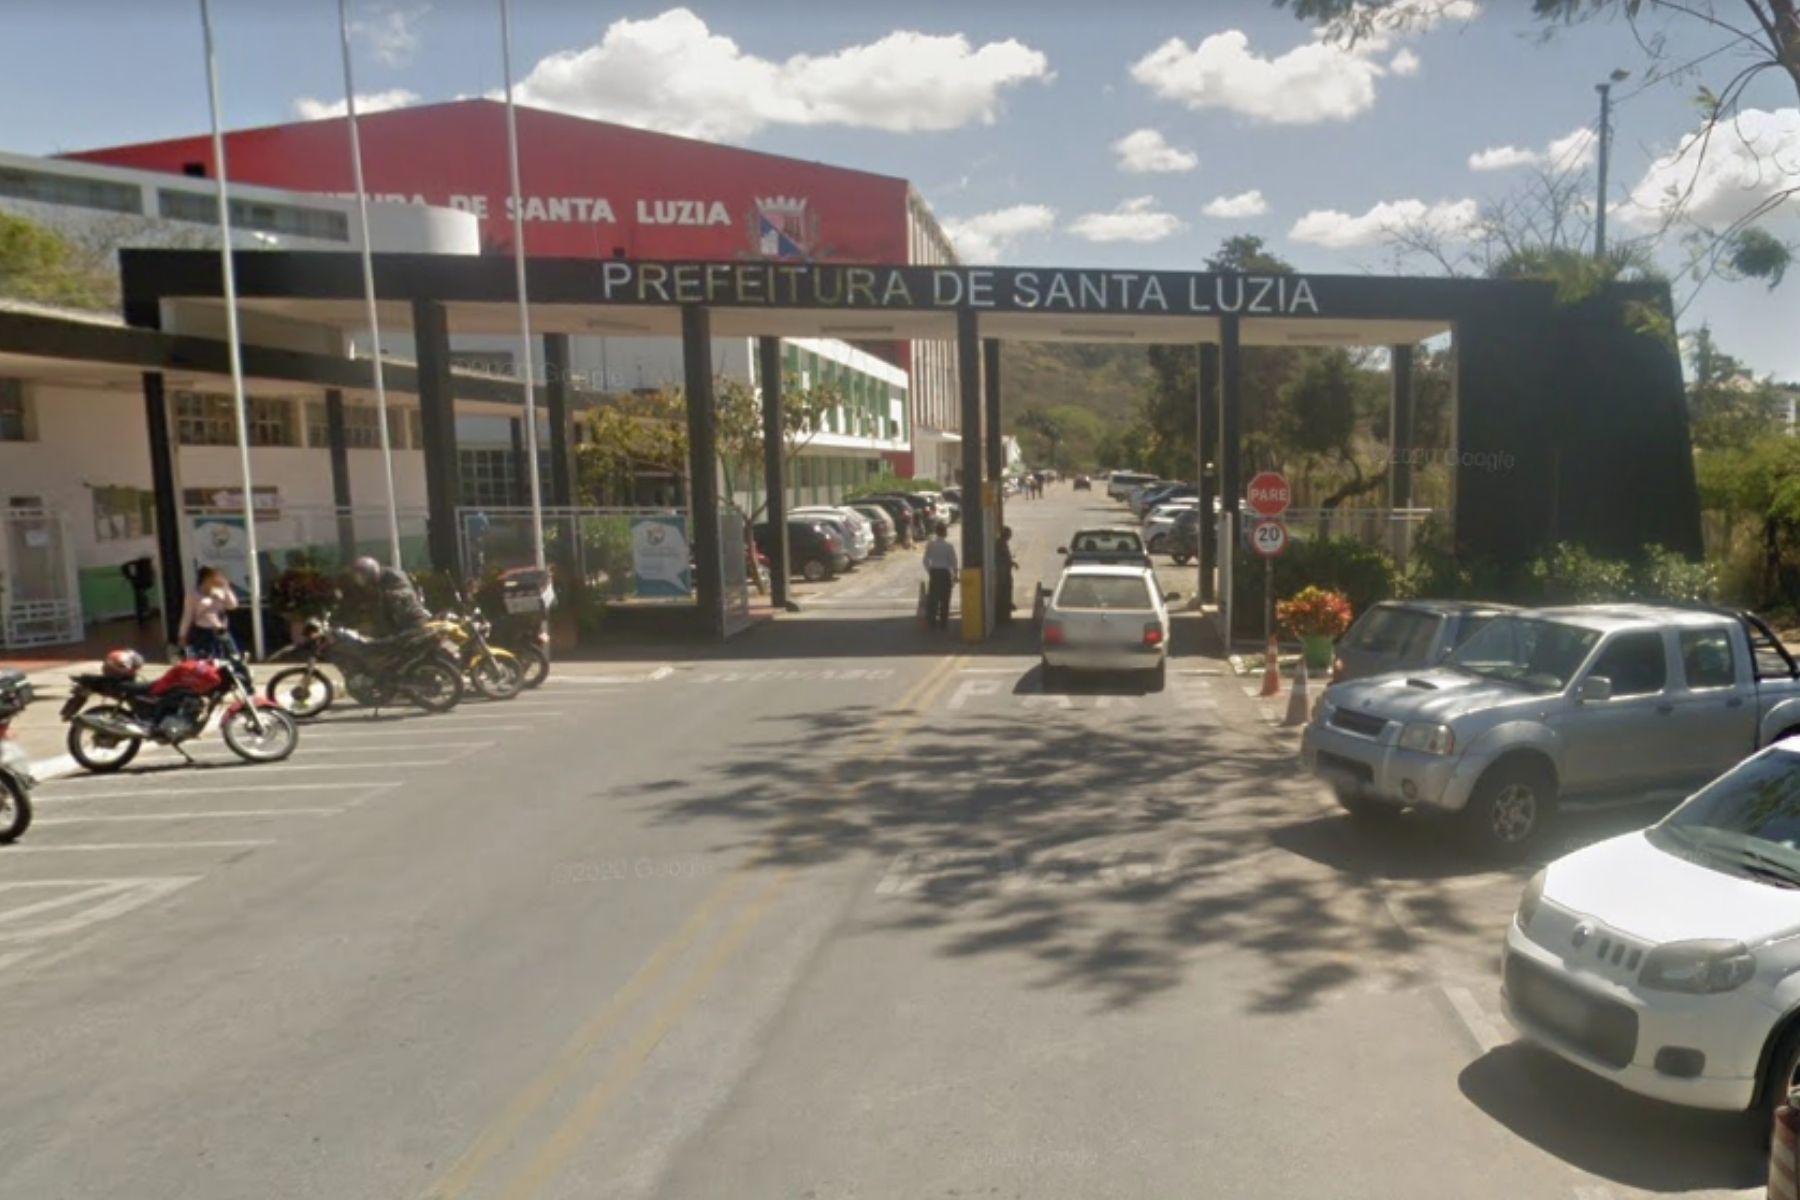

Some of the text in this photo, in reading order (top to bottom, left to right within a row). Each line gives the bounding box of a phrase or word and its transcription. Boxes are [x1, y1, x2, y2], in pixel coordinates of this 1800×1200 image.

[505, 196, 617, 223] SANTA
[636, 198, 732, 226] LUZIA
[602, 262, 1319, 314] PREFEITURA DE SANTA LUZIA
[1250, 488, 1288, 501] PARE
[1259, 527, 1280, 542] 20
